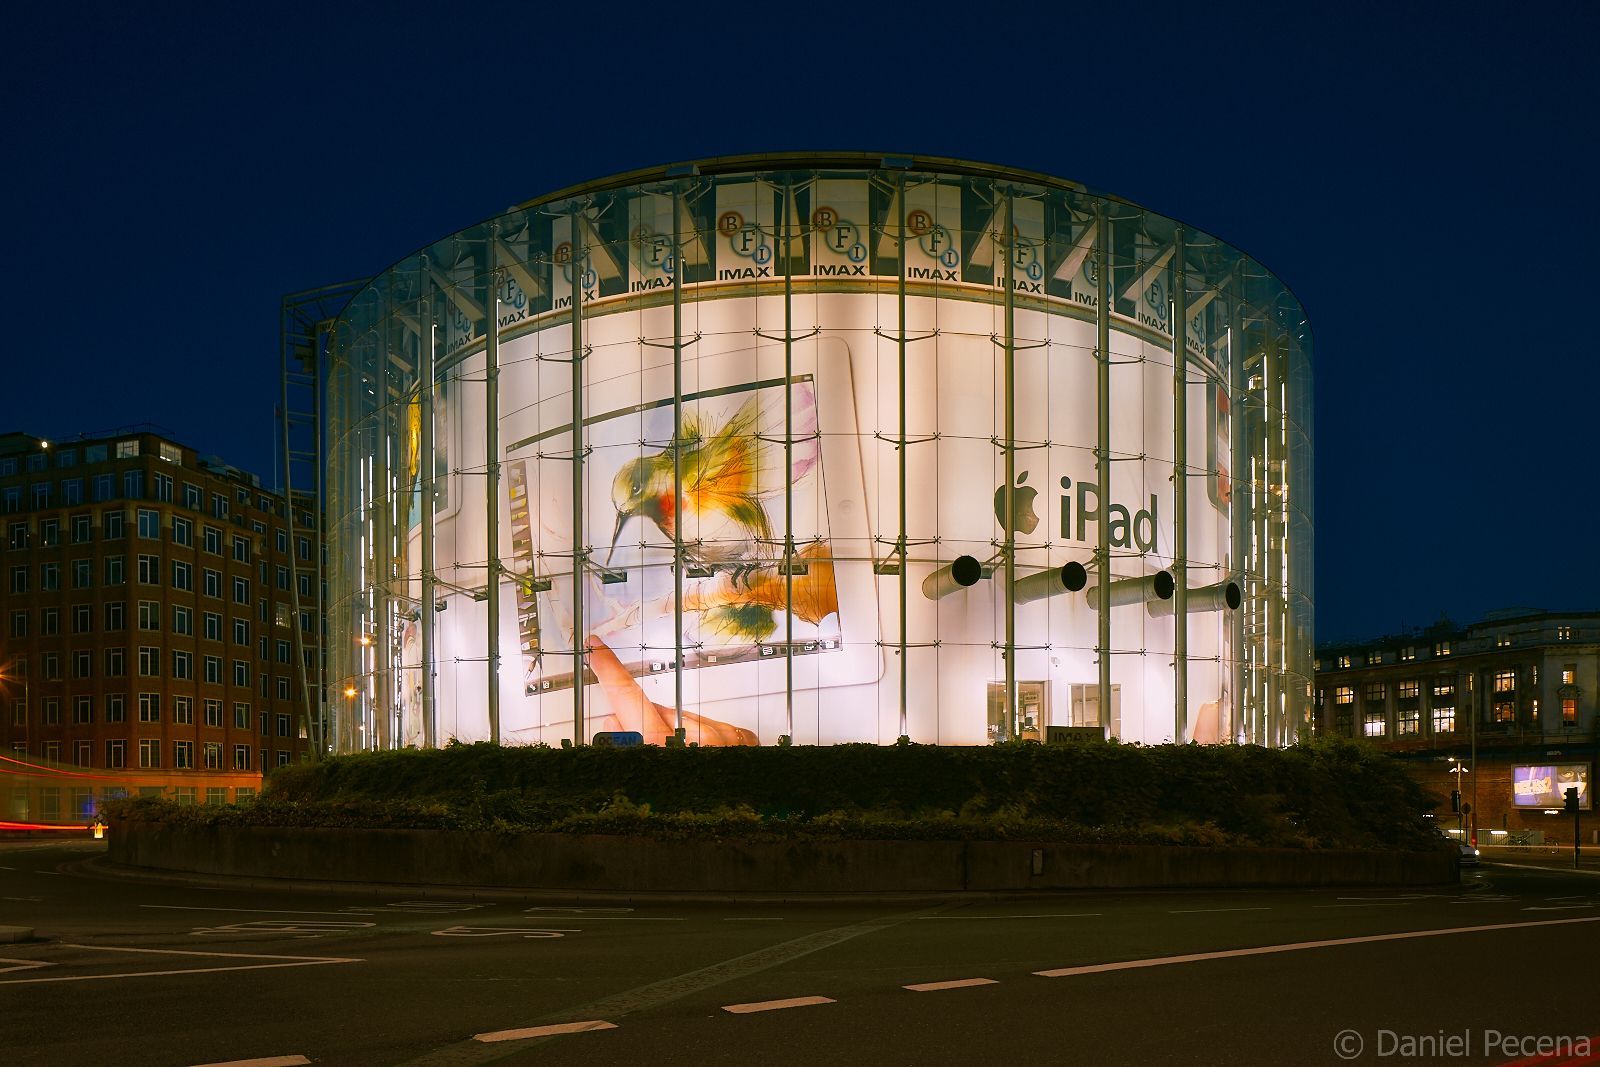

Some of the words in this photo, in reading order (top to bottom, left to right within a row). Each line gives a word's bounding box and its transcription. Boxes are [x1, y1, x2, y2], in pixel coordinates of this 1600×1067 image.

[719, 267, 770, 281] IMAX
[814, 265, 865, 276] IMAX
[908, 267, 958, 282] IMAX
[631, 276, 675, 293] IMAX
[554, 290, 596, 310] IMX
[498, 309, 526, 328] MAX
[1138, 312, 1167, 333] IMAX
[1186, 337, 1206, 356] MAX
[1060, 476, 1158, 553] iPad
